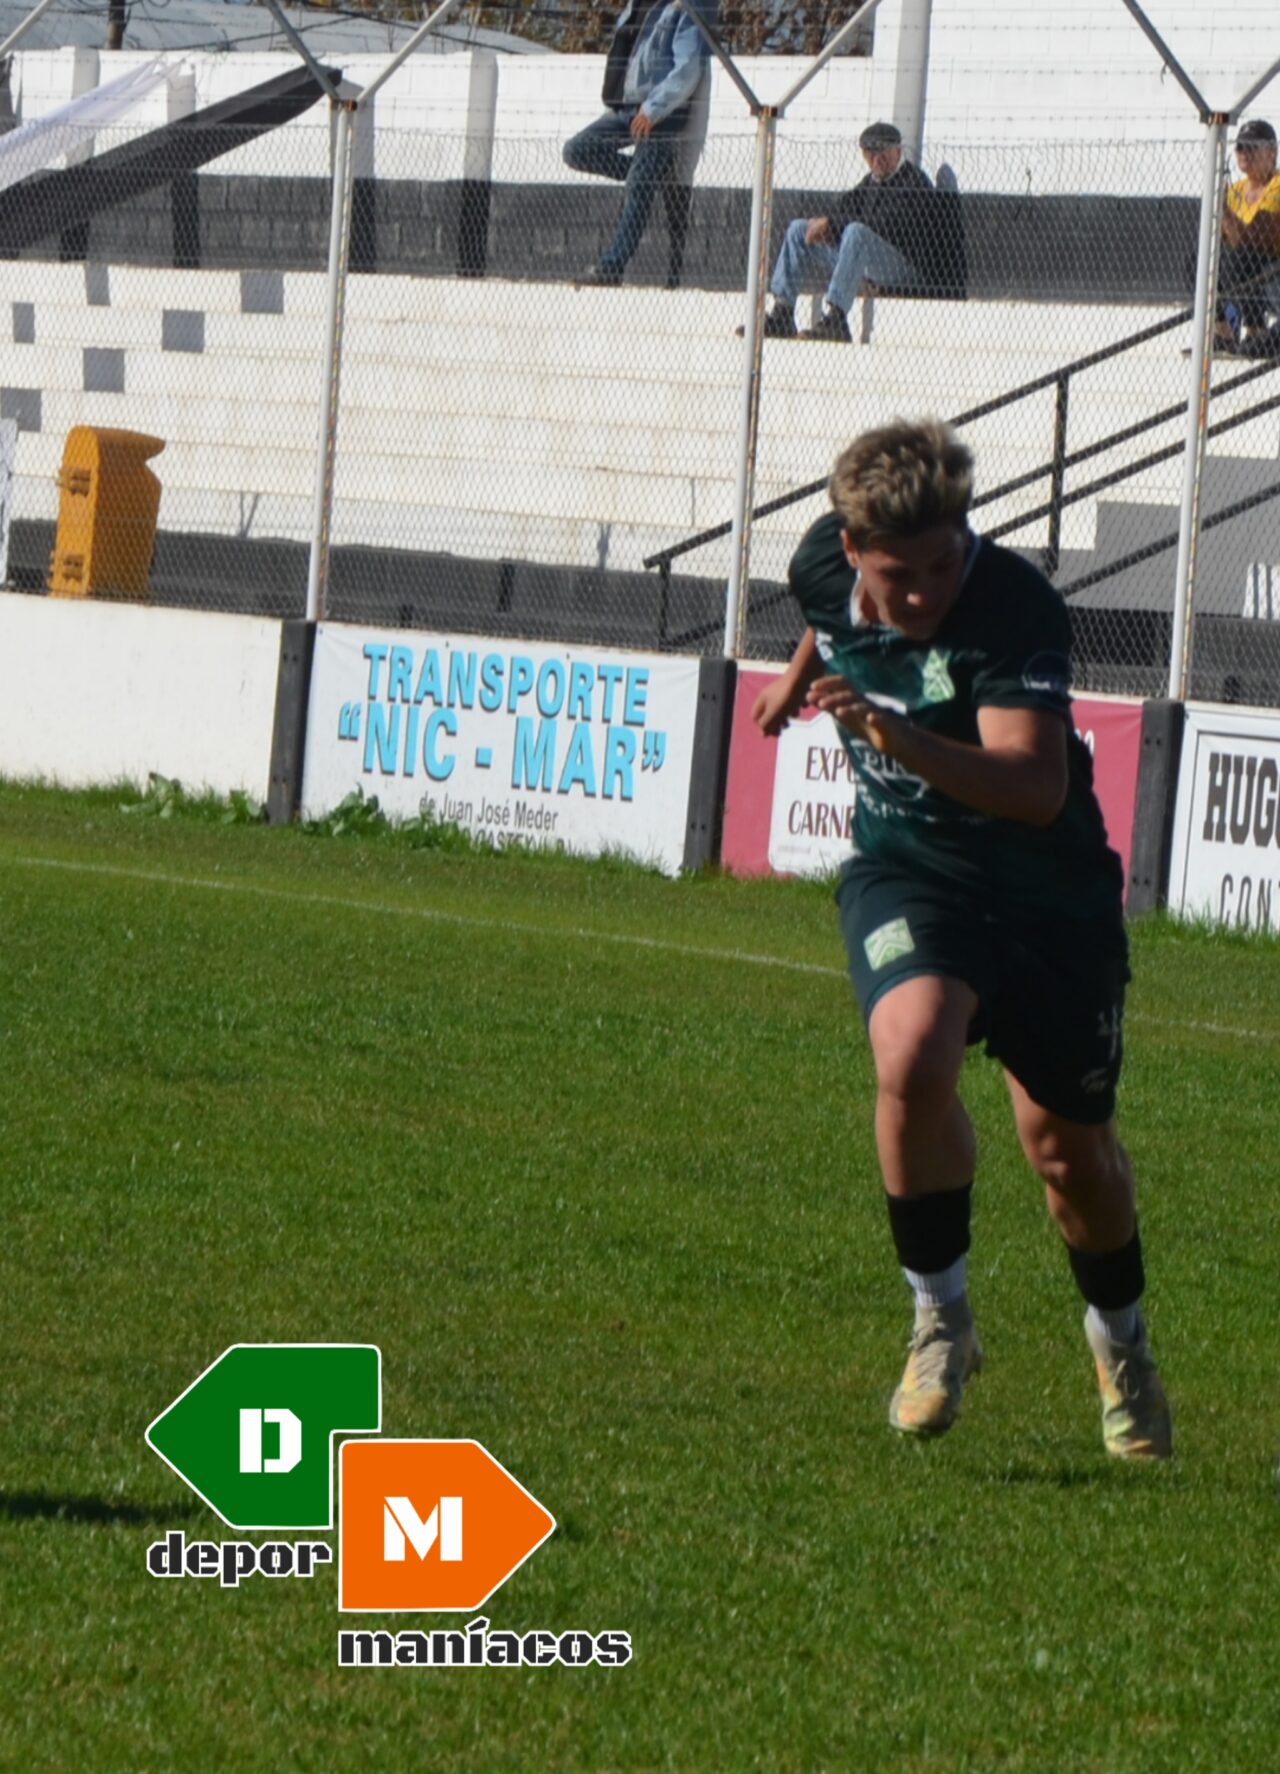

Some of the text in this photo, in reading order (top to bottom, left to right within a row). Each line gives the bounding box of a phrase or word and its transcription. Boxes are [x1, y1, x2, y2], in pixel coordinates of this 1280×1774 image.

[363, 643, 650, 727] TRANSPORTE
[439, 793, 473, 824] Juan
[477, 796, 511, 828] José
[514, 800, 560, 832] Meder
